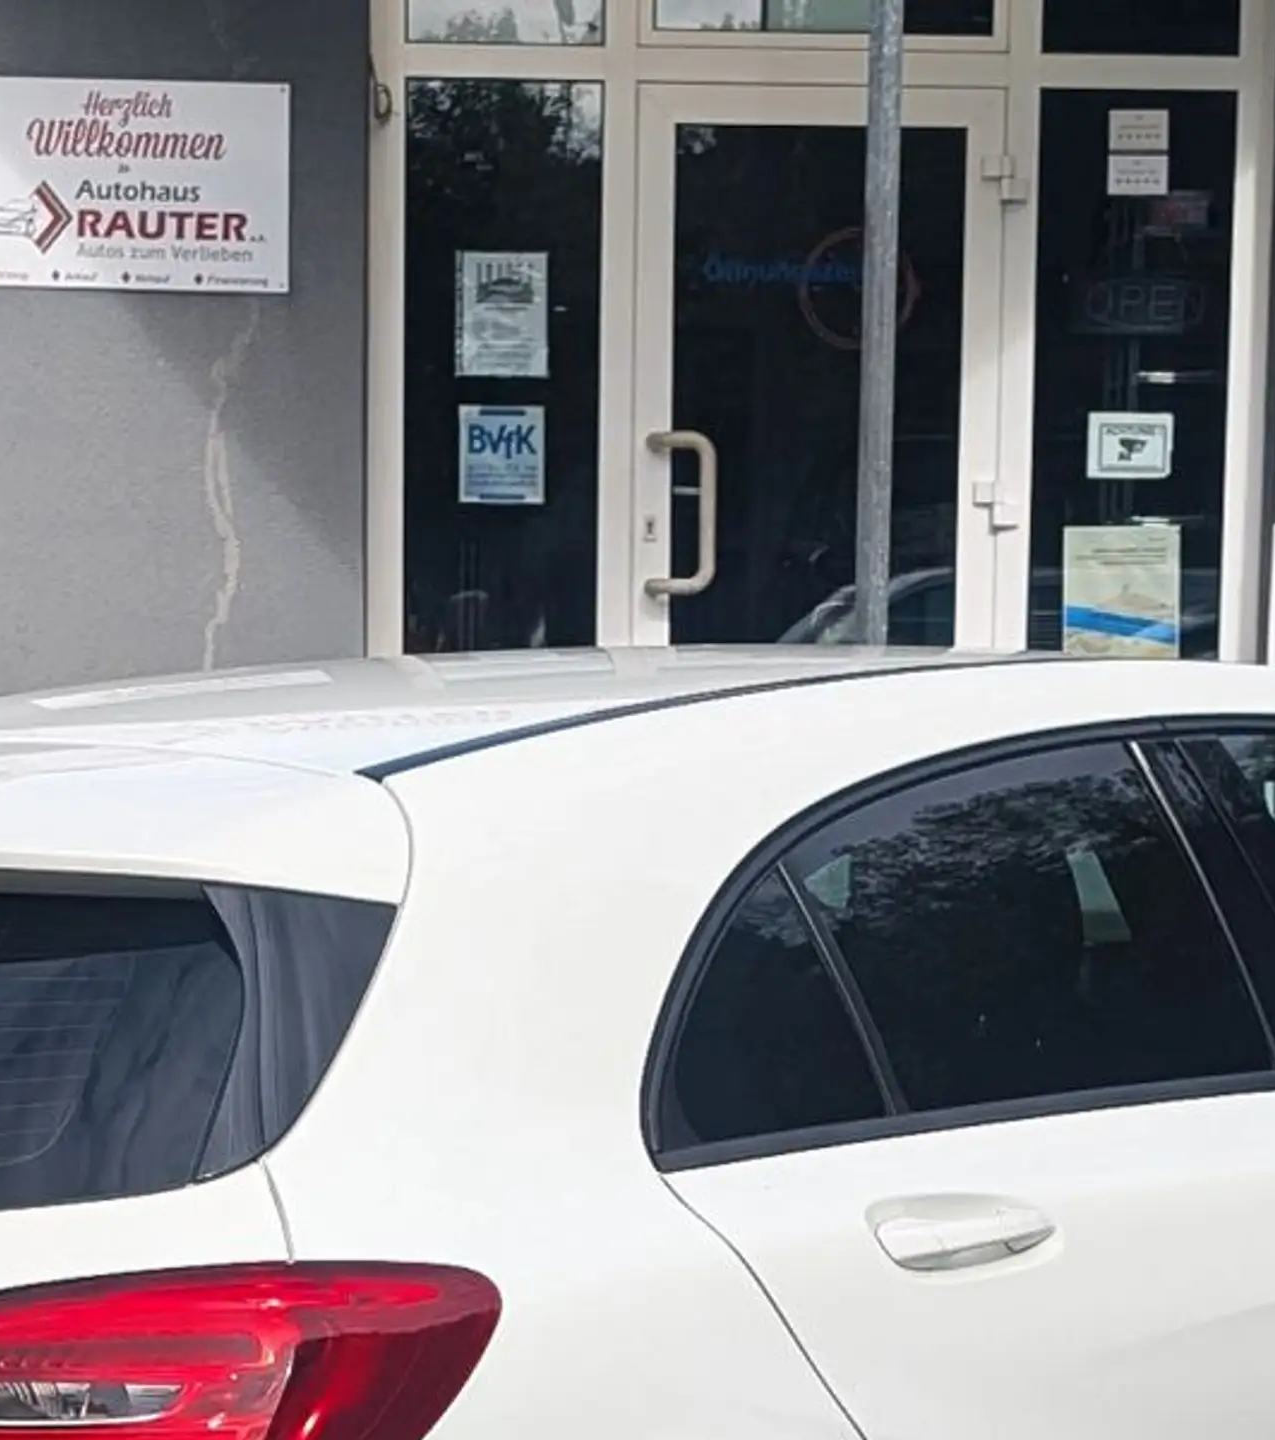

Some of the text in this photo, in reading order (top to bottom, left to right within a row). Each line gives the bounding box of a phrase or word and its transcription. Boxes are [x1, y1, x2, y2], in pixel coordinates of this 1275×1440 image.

[82, 90, 173, 127] Herzlich
[26, 118, 227, 161] Willkommen
[74, 179, 201, 203] Autohaus
[76, 208, 248, 242] RAUTER
[76, 242, 253, 263] Autos zum Verlieben
[467, 423, 538, 460] BVfK
